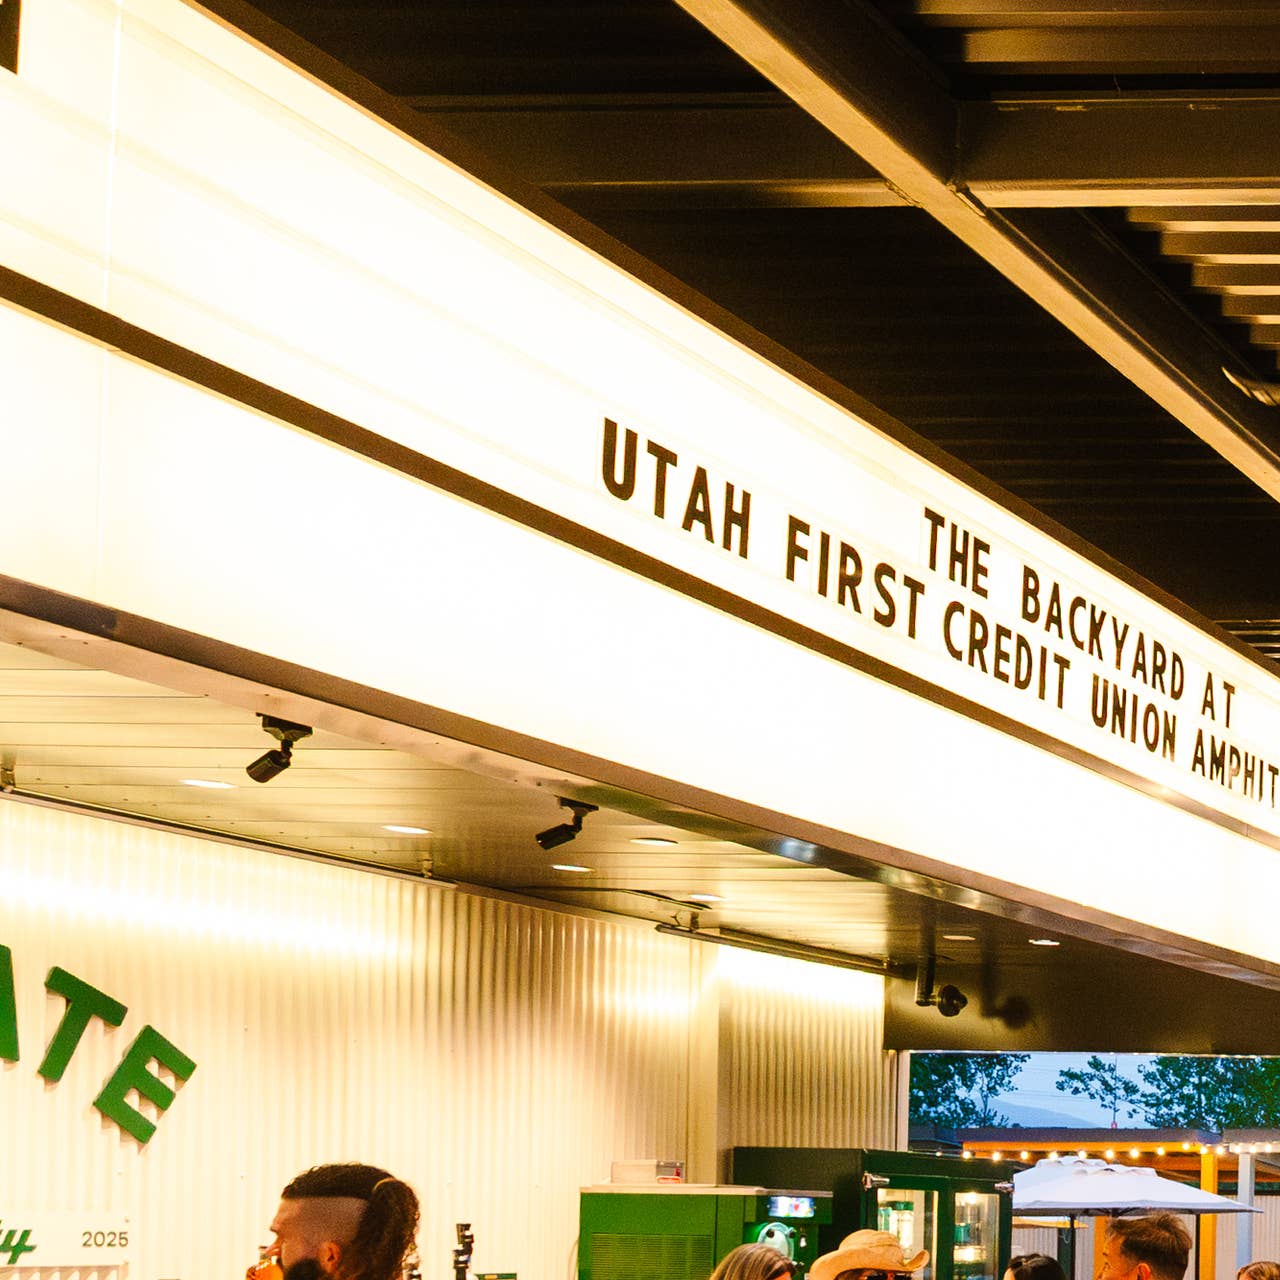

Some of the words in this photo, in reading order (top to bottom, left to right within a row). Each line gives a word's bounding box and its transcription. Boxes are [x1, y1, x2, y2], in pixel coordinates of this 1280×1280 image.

[602, 417, 752, 561] UTAH
[786, 514, 926, 640] FIRST
[943, 600, 1072, 711] CREDIT
[1091, 674, 1177, 762] UNION
[924, 506, 991, 600] THE
[1021, 564, 1186, 702] BACKYARD
[1201, 671, 1236, 729] AT
[0, 943, 198, 1146] TE
[82, 1231, 129, 1247] 2025
